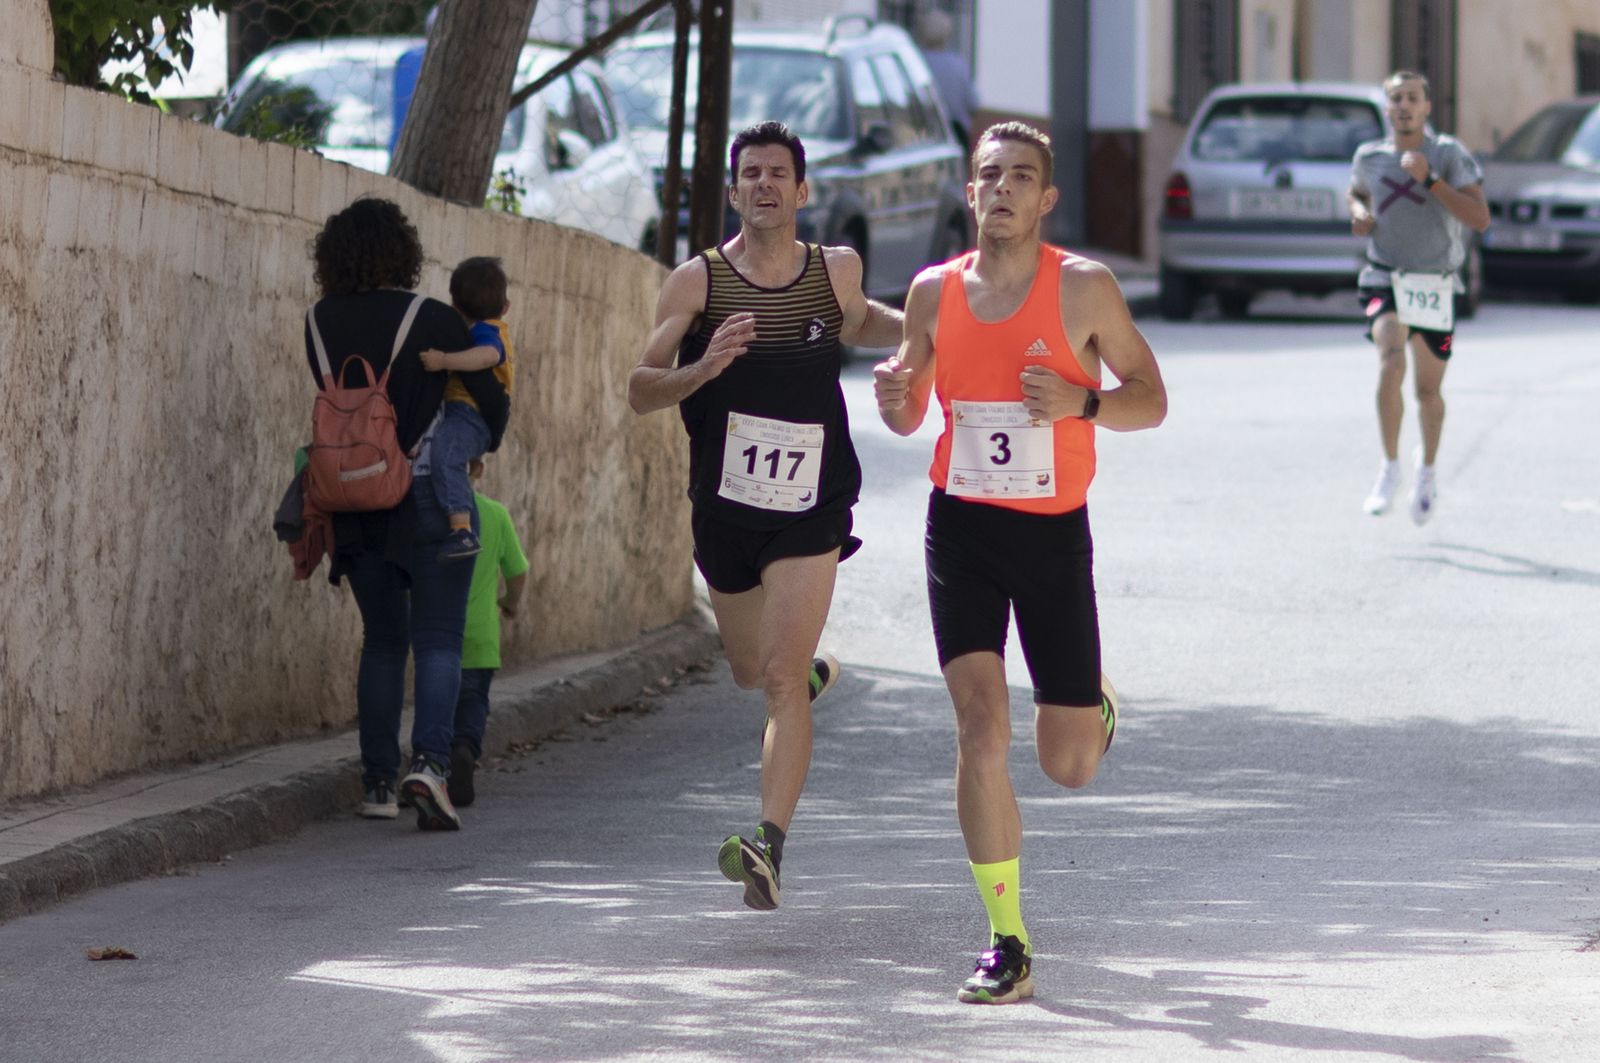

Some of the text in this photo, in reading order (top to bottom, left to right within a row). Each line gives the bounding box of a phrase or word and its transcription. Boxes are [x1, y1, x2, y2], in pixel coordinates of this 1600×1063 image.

[1404, 290, 1440, 310] 792
[742, 445, 806, 481] 117
[989, 432, 1012, 465] 3
